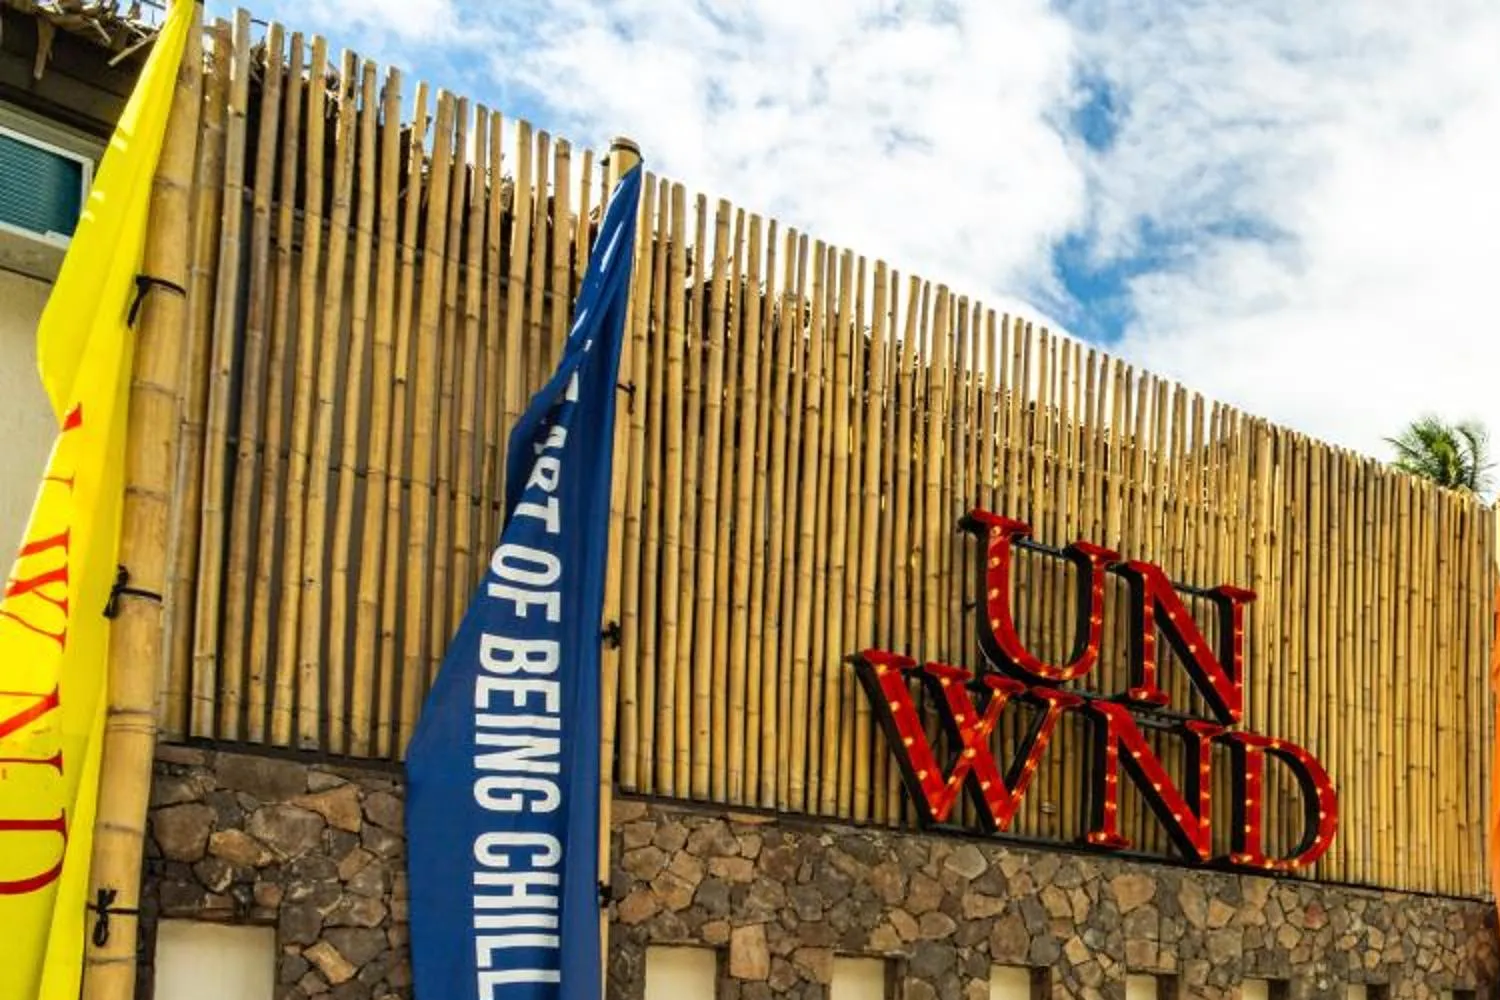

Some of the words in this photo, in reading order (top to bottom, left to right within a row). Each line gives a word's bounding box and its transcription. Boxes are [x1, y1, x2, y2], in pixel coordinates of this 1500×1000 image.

[487, 543, 561, 623] OF
[964, 508, 1257, 724] UN
[473, 632, 561, 814] BEING
[856, 649, 1338, 872] WND
